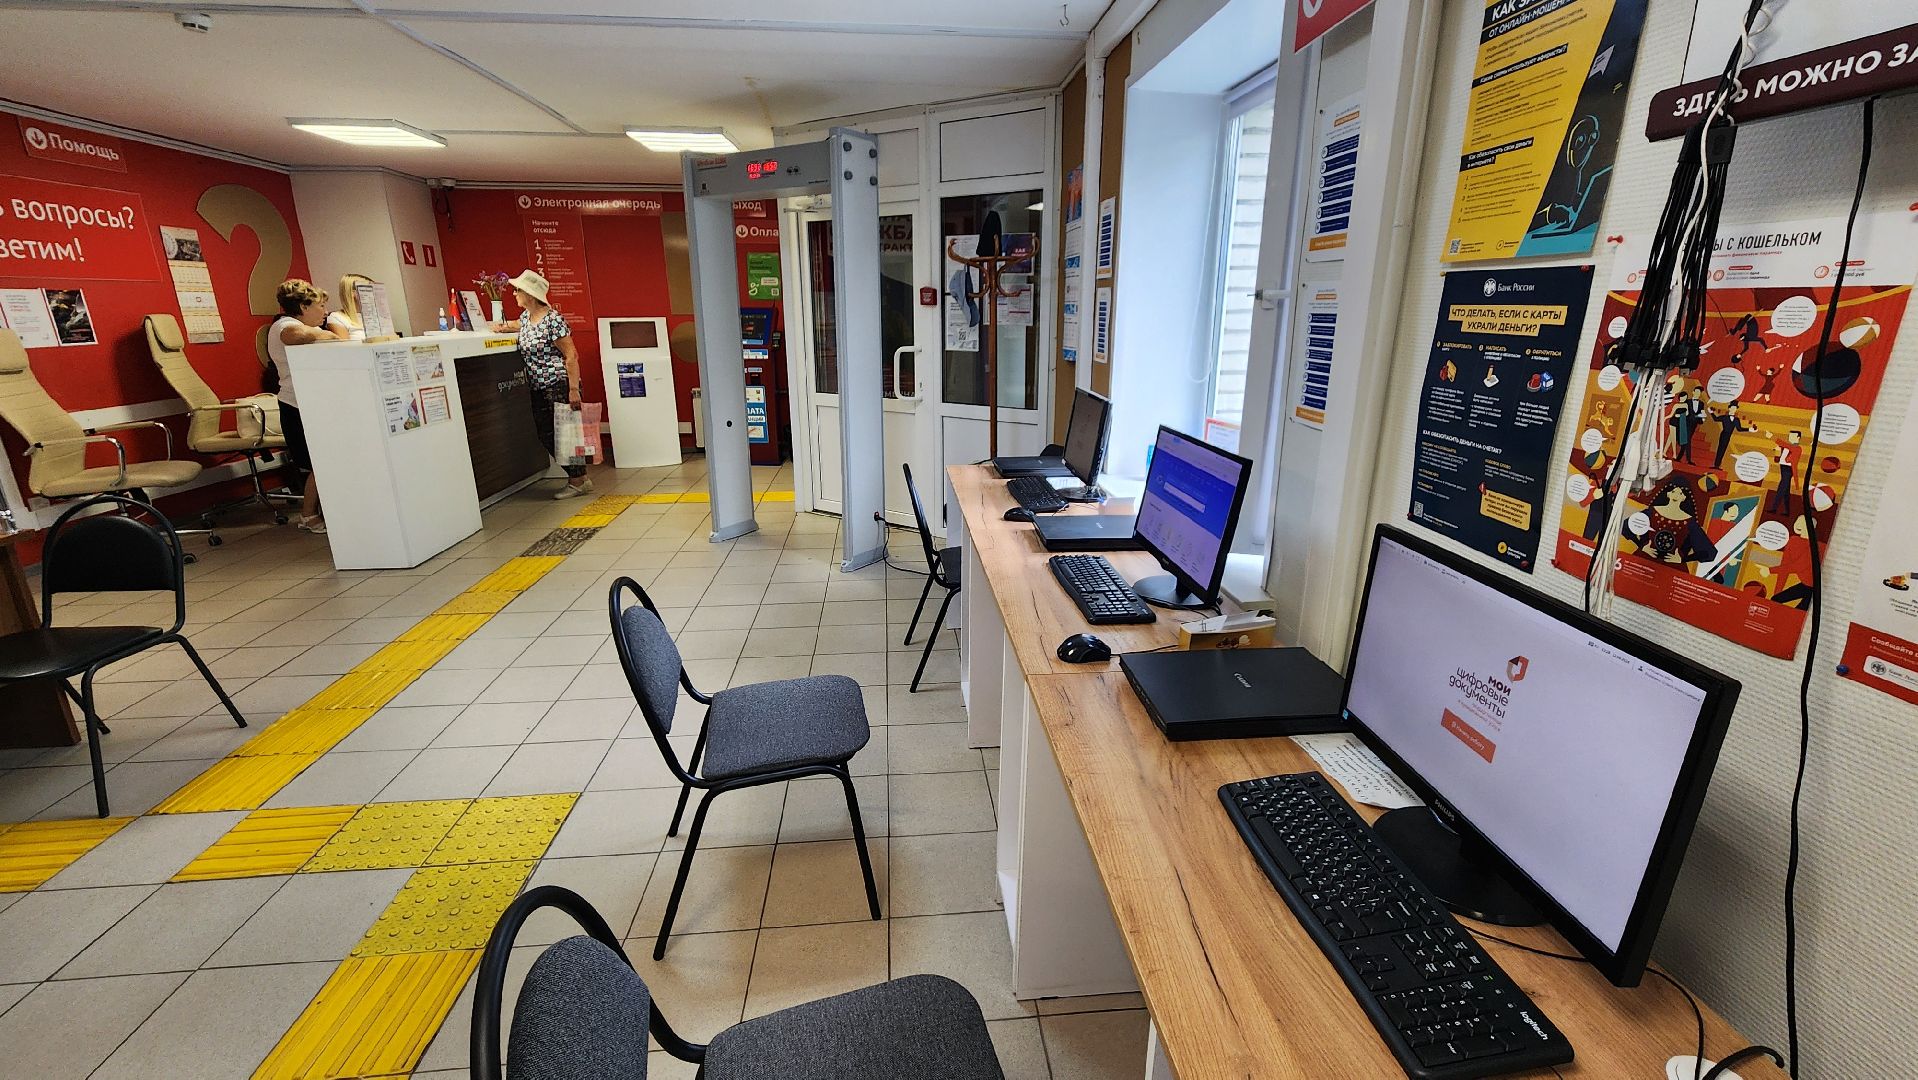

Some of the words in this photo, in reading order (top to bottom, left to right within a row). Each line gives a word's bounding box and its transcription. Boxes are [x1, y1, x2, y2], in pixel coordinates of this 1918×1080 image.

[1488, 26, 1498, 38] ОТ
[1754, 51, 1882, 98] МОЖНО
[49, 132, 120, 162] Помощь
[533, 197, 610, 210] Электронная
[611, 198, 661, 211] очередь
[11, 199, 135, 230] вопросы?
[1727, 240, 1734, 250] С
[1737, 231, 1823, 250] КОШЕЛЬКОМ
[1497, 283, 1512, 292] Банк
[1513, 283, 1535, 292] России
[1451, 309, 1466, 317] ЧТО
[1466, 309, 1497, 319] ДЕЛАТЬ,
[1498, 310, 1521, 318] ЕСЛИ
[1522, 311, 1530, 319] С
[1530, 311, 1562, 320] КАРТЫ
[1467, 321, 1498, 331] УКРАЛИ
[1498, 323, 1538, 333] ДЕНЬГИ?
[1871, 636, 1914, 656] Сообщайте
[1456, 667, 1509, 706] цифровые
[1488, 676, 1511, 696] мои
[1449, 675, 1506, 718] документы
[1520, 1011, 1548, 1040] logitech
